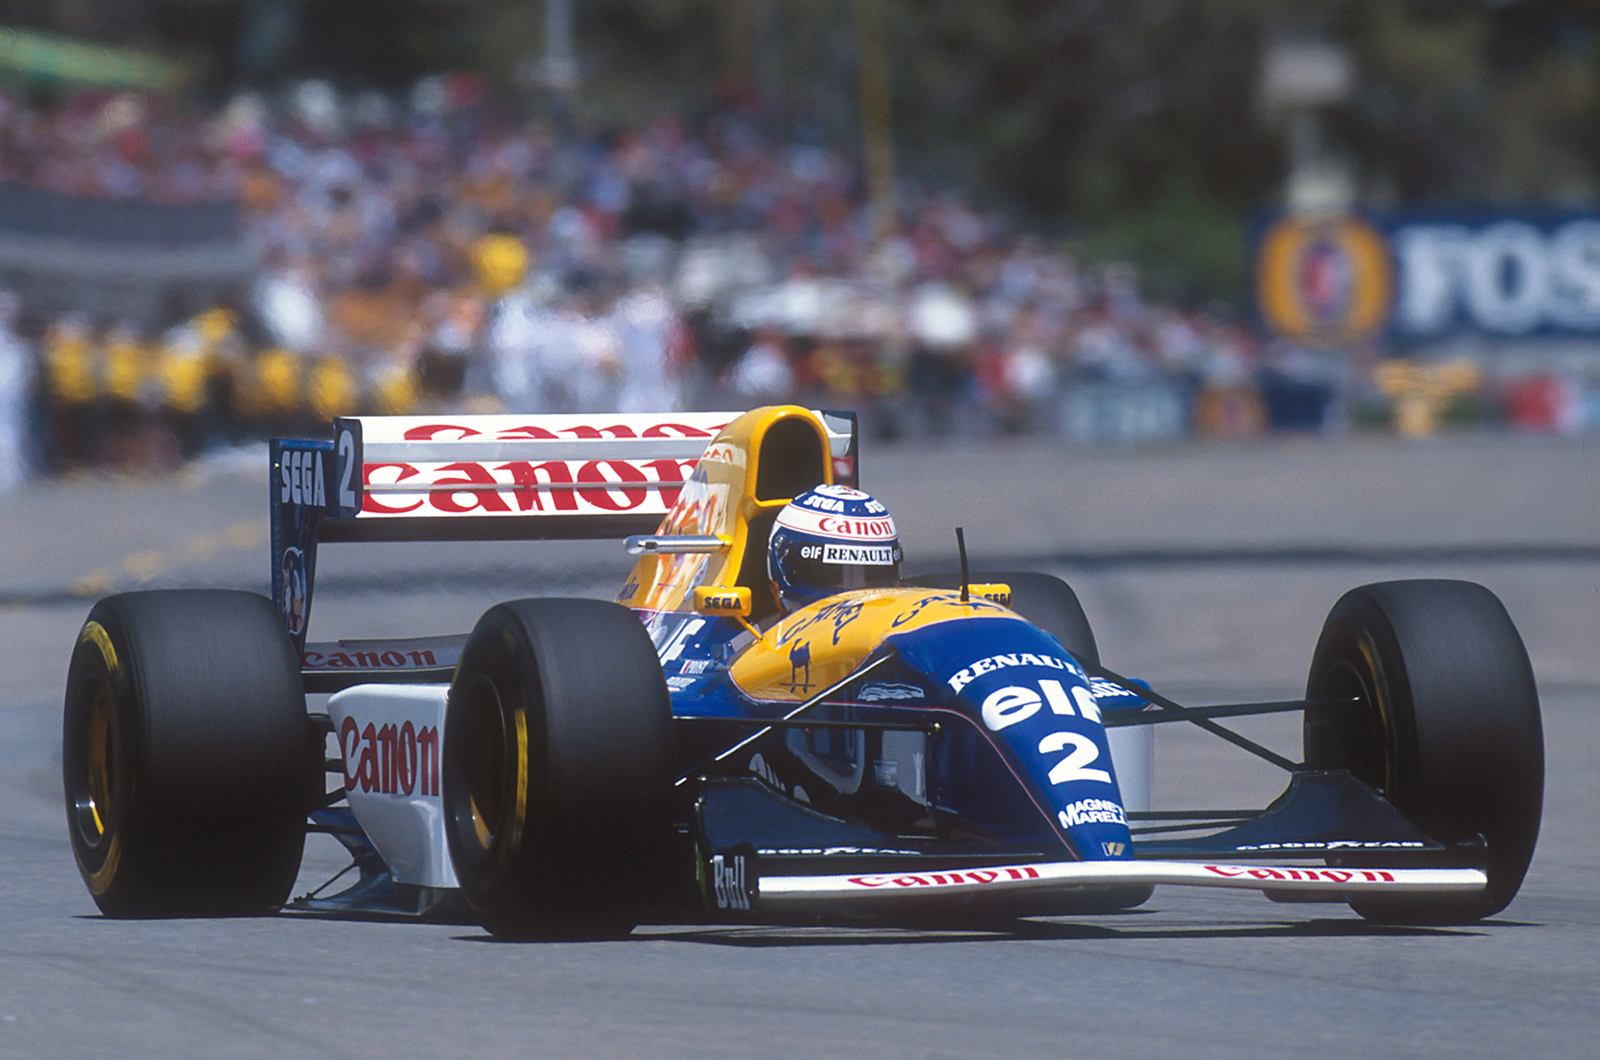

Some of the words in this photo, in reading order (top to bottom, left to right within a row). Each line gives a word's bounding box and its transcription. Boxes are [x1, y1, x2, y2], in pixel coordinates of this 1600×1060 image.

[281, 450, 326, 507] SEGA
[338, 429, 355, 508] 2
[818, 517, 893, 536] Canon
[801, 545, 823, 560] elf
[827, 547, 891, 562] RENAULT
[703, 596, 742, 610] SEGA
[302, 649, 438, 670] Canon
[947, 653, 1088, 695] RENAUL
[341, 716, 439, 797] Canon
[1038, 731, 1112, 785] 2
[847, 867, 1040, 888] Canon
[1203, 865, 1395, 883] Canon
